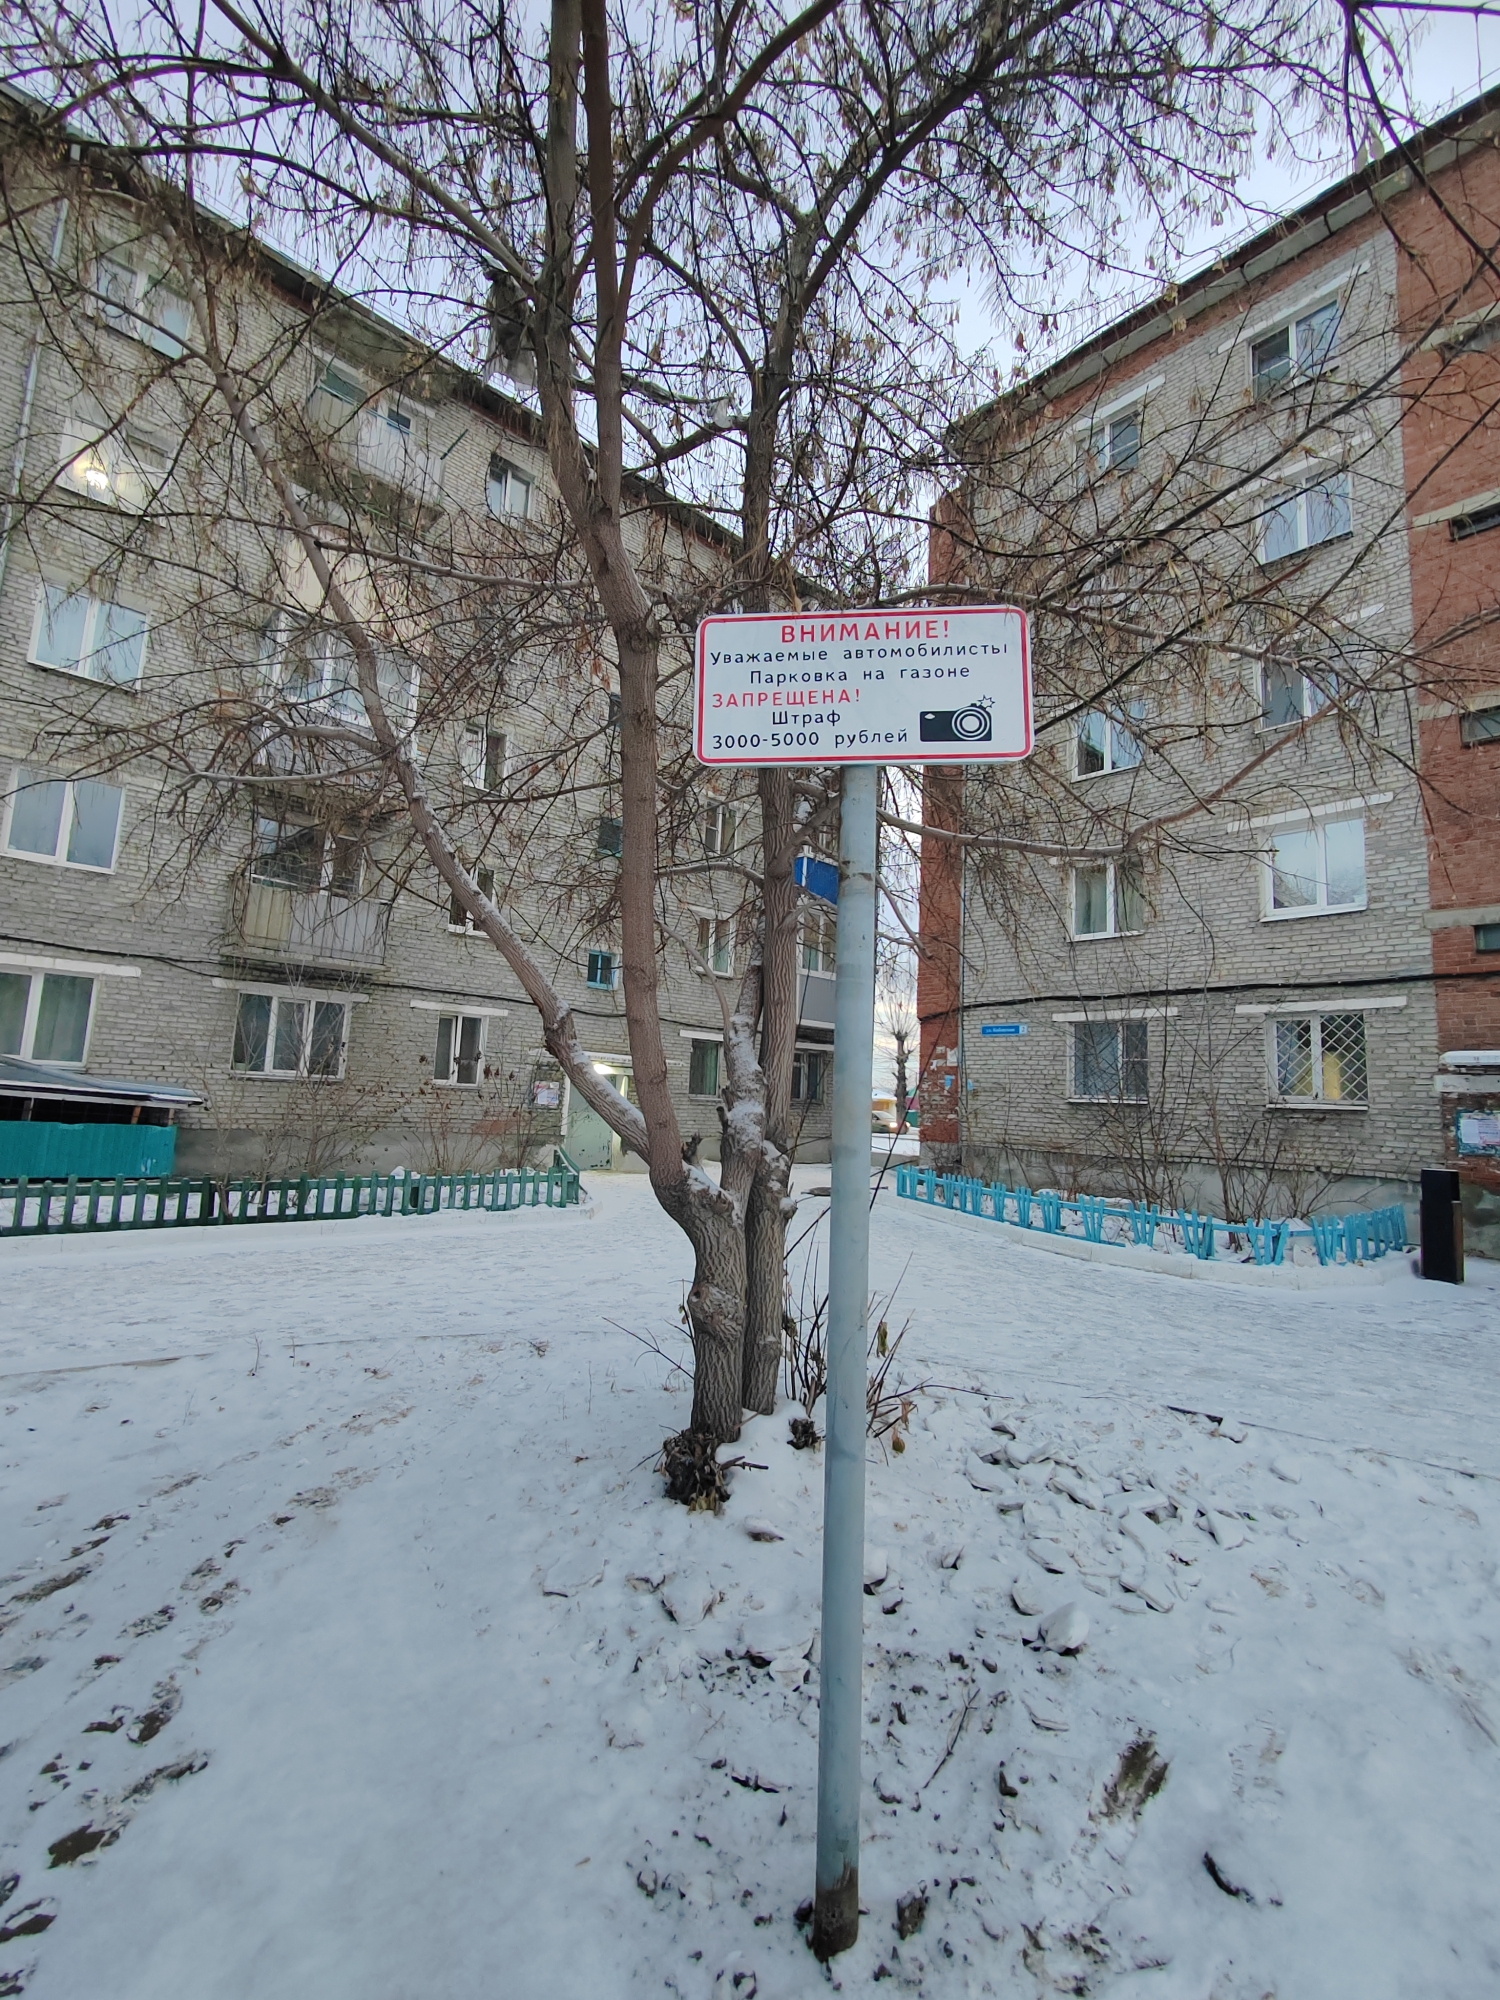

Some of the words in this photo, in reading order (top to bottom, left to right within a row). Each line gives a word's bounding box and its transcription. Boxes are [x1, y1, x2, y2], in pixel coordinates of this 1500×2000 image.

[781, 620, 949, 643] ВНИМАНИЕ!
[710, 650, 828, 666] Уважаемые
[843, 643, 1007, 660] автомобилисты
[750, 670, 848, 687] Парковка
[863, 669, 885, 680] на
[900, 666, 970, 679] газоне
[712, 688, 860, 709] ЗАПРЕЩЕНА!
[772, 709, 841, 727] Штраф
[712, 731, 820, 750] 3000-5000
[834, 728, 908, 749] рублей
